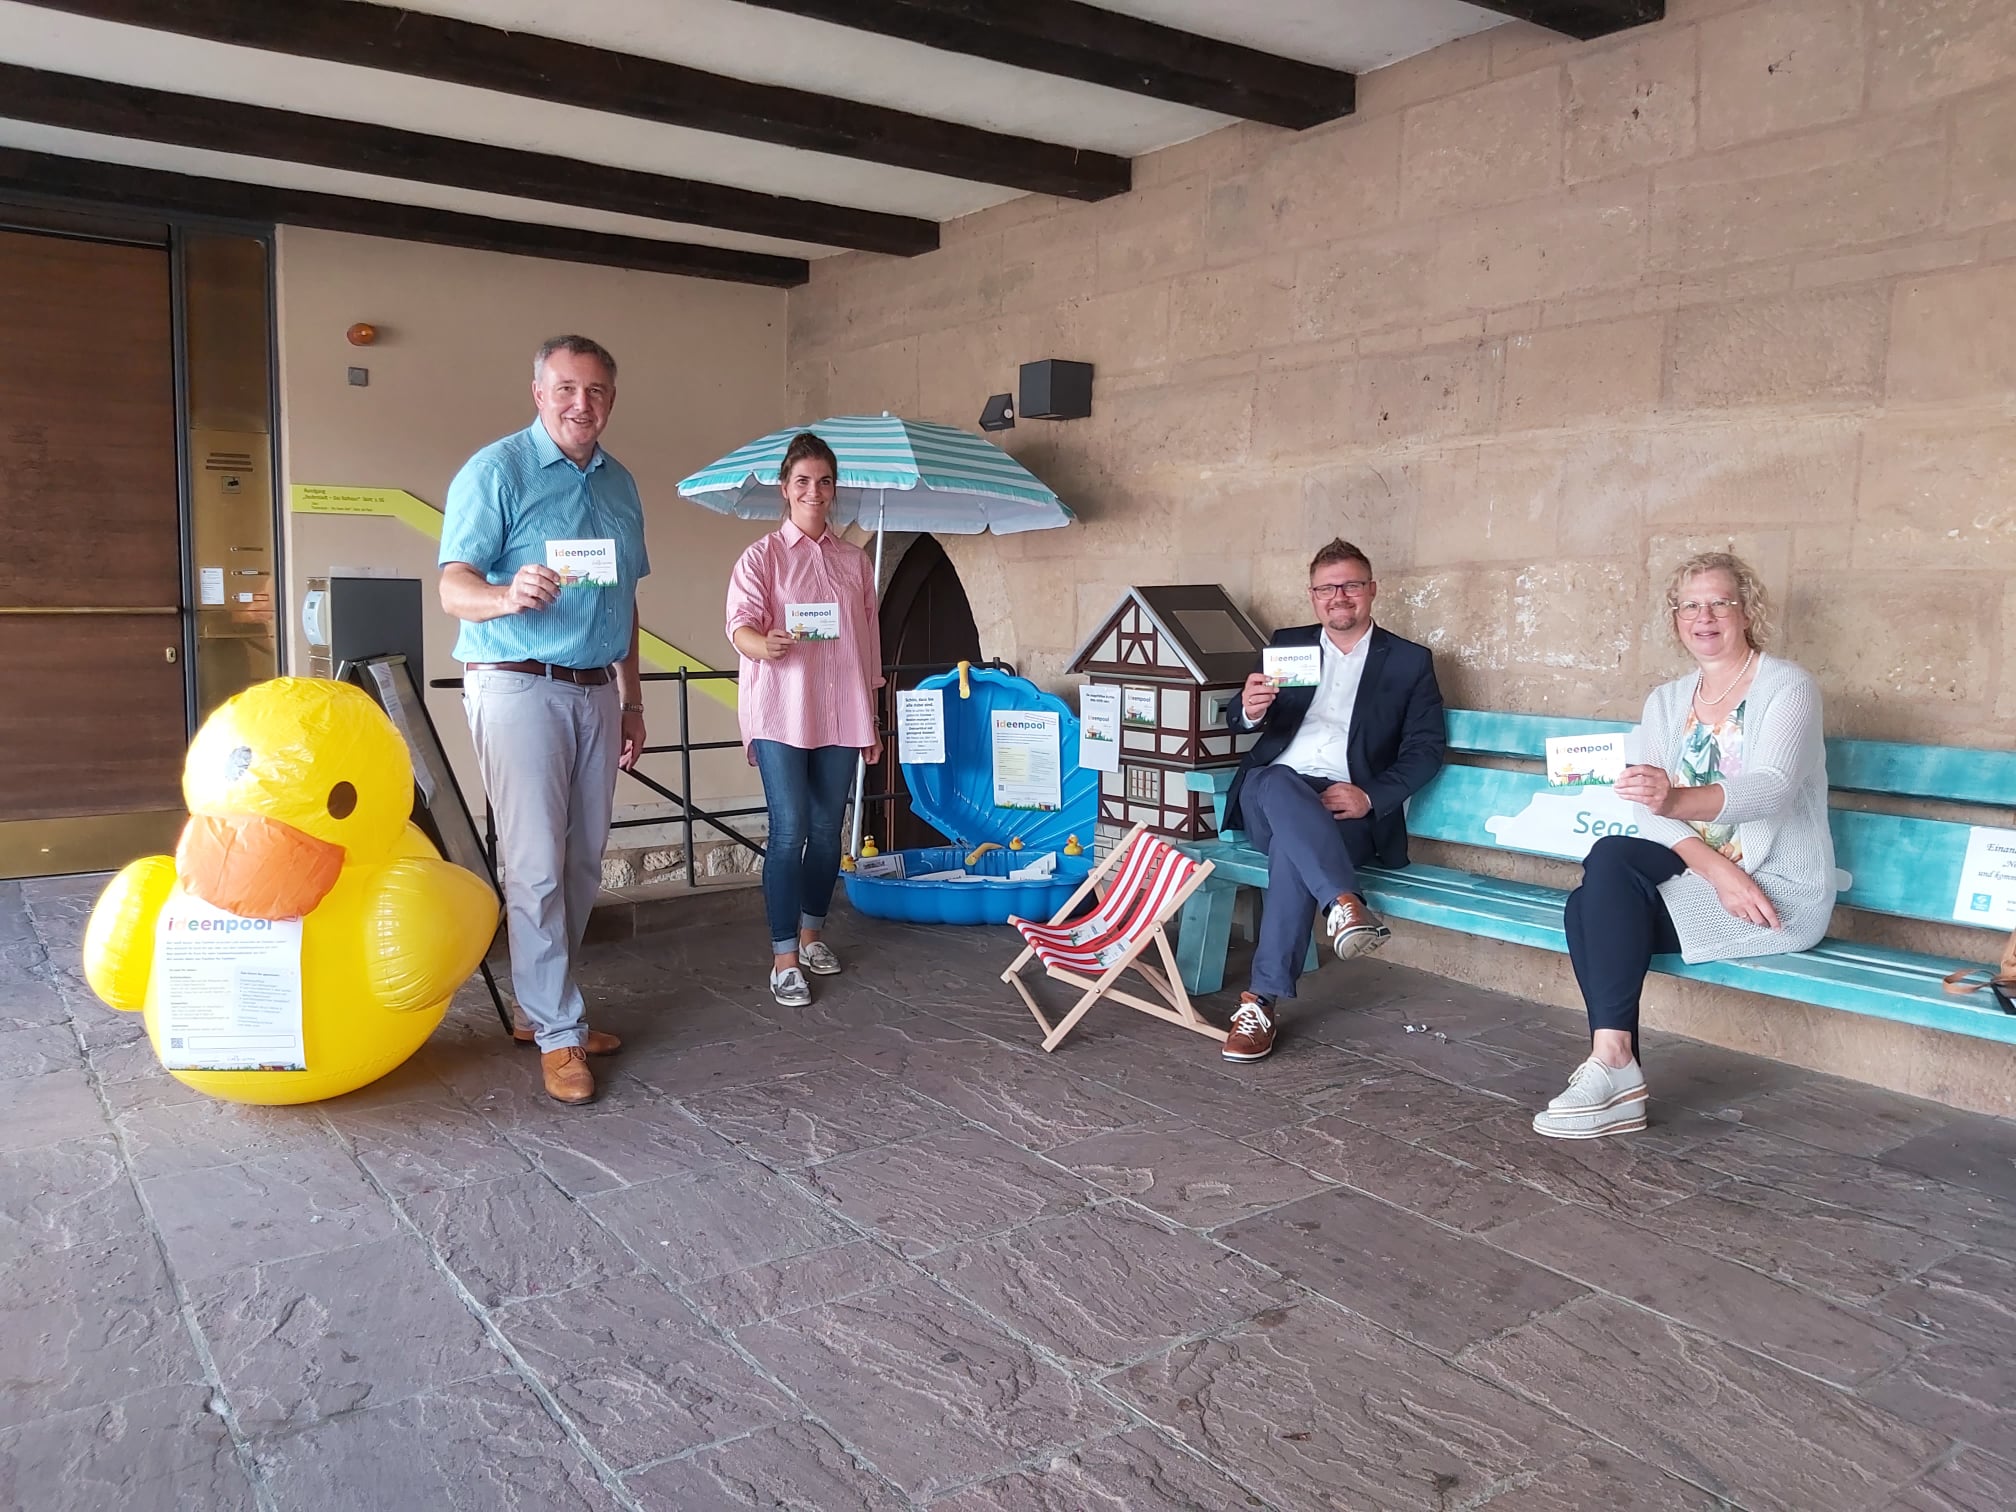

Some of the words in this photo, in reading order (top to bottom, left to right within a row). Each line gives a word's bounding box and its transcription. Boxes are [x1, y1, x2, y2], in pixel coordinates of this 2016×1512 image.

[555, 547, 606, 558] ideenpool
[791, 609, 832, 618] ideenpool
[1270, 653, 1313, 663] ideenpool
[996, 720, 1045, 730] ideenpool
[1556, 743, 1613, 755] ideenpool
[1987, 843, 2016, 853] Einan
[168, 917, 273, 934] ideenpool
